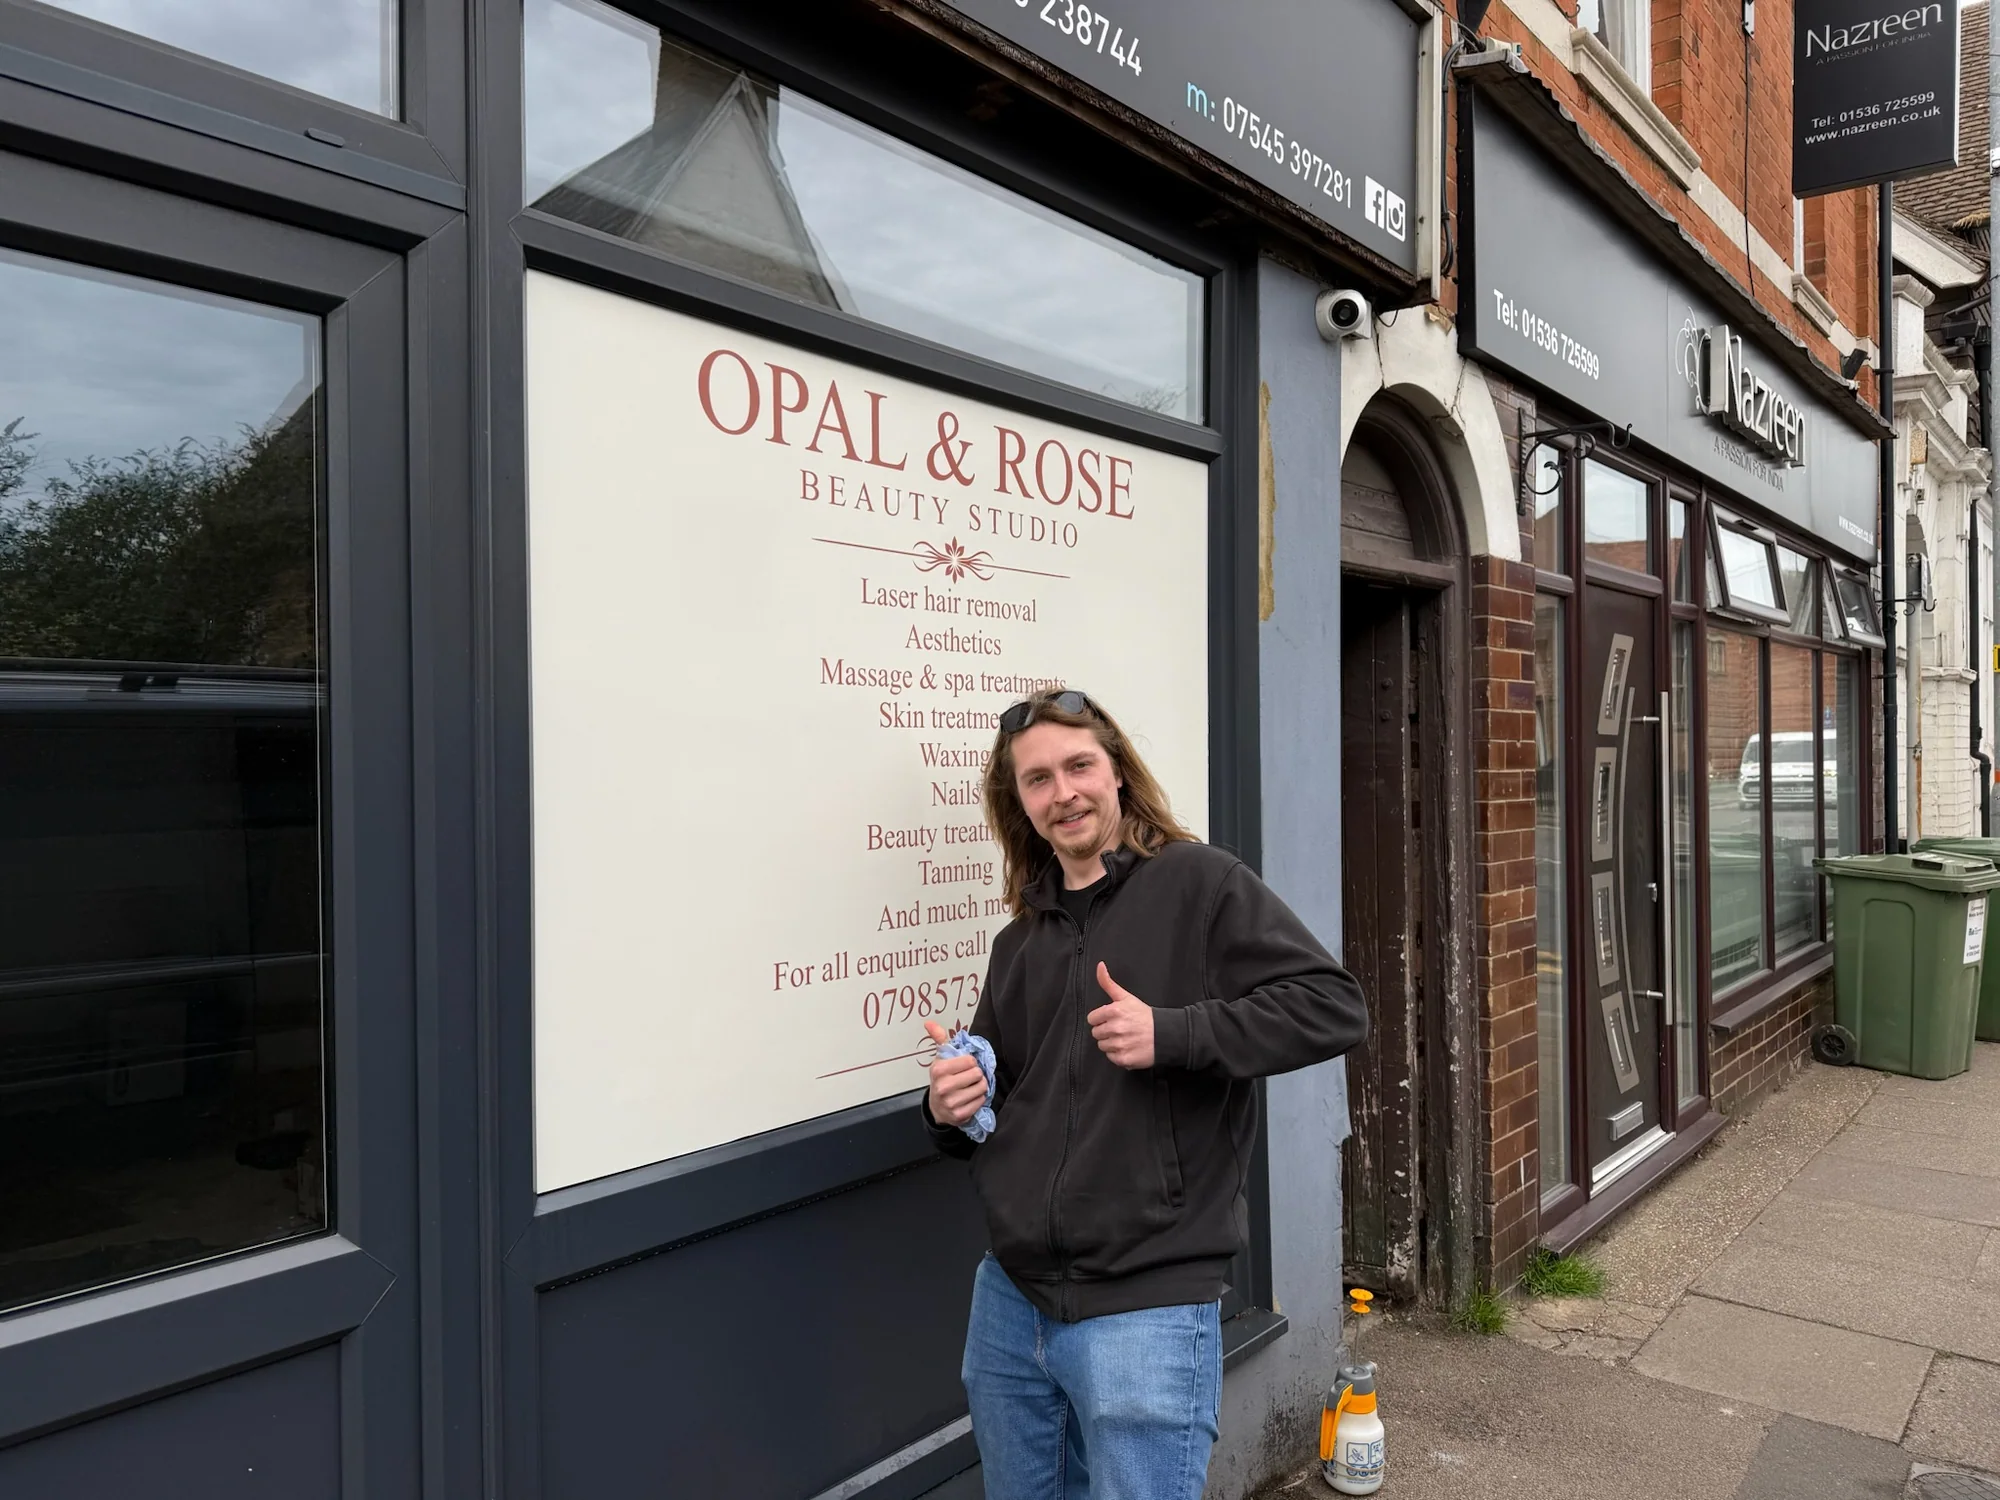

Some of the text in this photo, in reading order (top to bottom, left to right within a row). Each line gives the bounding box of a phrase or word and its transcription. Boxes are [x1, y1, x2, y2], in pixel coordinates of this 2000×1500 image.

[1040, 0, 1142, 76] 238744
[1805, 3, 1943, 57] Nazreen
[1804, 105, 1941, 145] www.nazreen.co.uk
[1811, 91, 1935, 130] Tel: 01536 725599
[1187, 82, 1352, 209] m: 07545 397281
[1493, 288, 1600, 381] Tel: 01536 725599
[1712, 324, 1807, 471] Nazreen
[698, 349, 1136, 521] OPAL & ROSE
[799, 468, 1080, 549] BEAUTY STUDIO
[860, 577, 1038, 623] Laser hair removal
[904, 624, 1003, 656] Aesthetics
[819, 656, 914, 696] Massage
[919, 663, 938, 691] &
[944, 671, 976, 699] spa
[879, 701, 1001, 730] Skin treatme
[919, 741, 991, 774] Waxing
[930, 779, 981, 807] Nails
[866, 823, 938, 854] Beauty
[917, 856, 994, 887] Tanning
[876, 893, 1012, 932] And much mo
[772, 929, 988, 992] For all enquiries call
[862, 972, 981, 1030] 0798573
